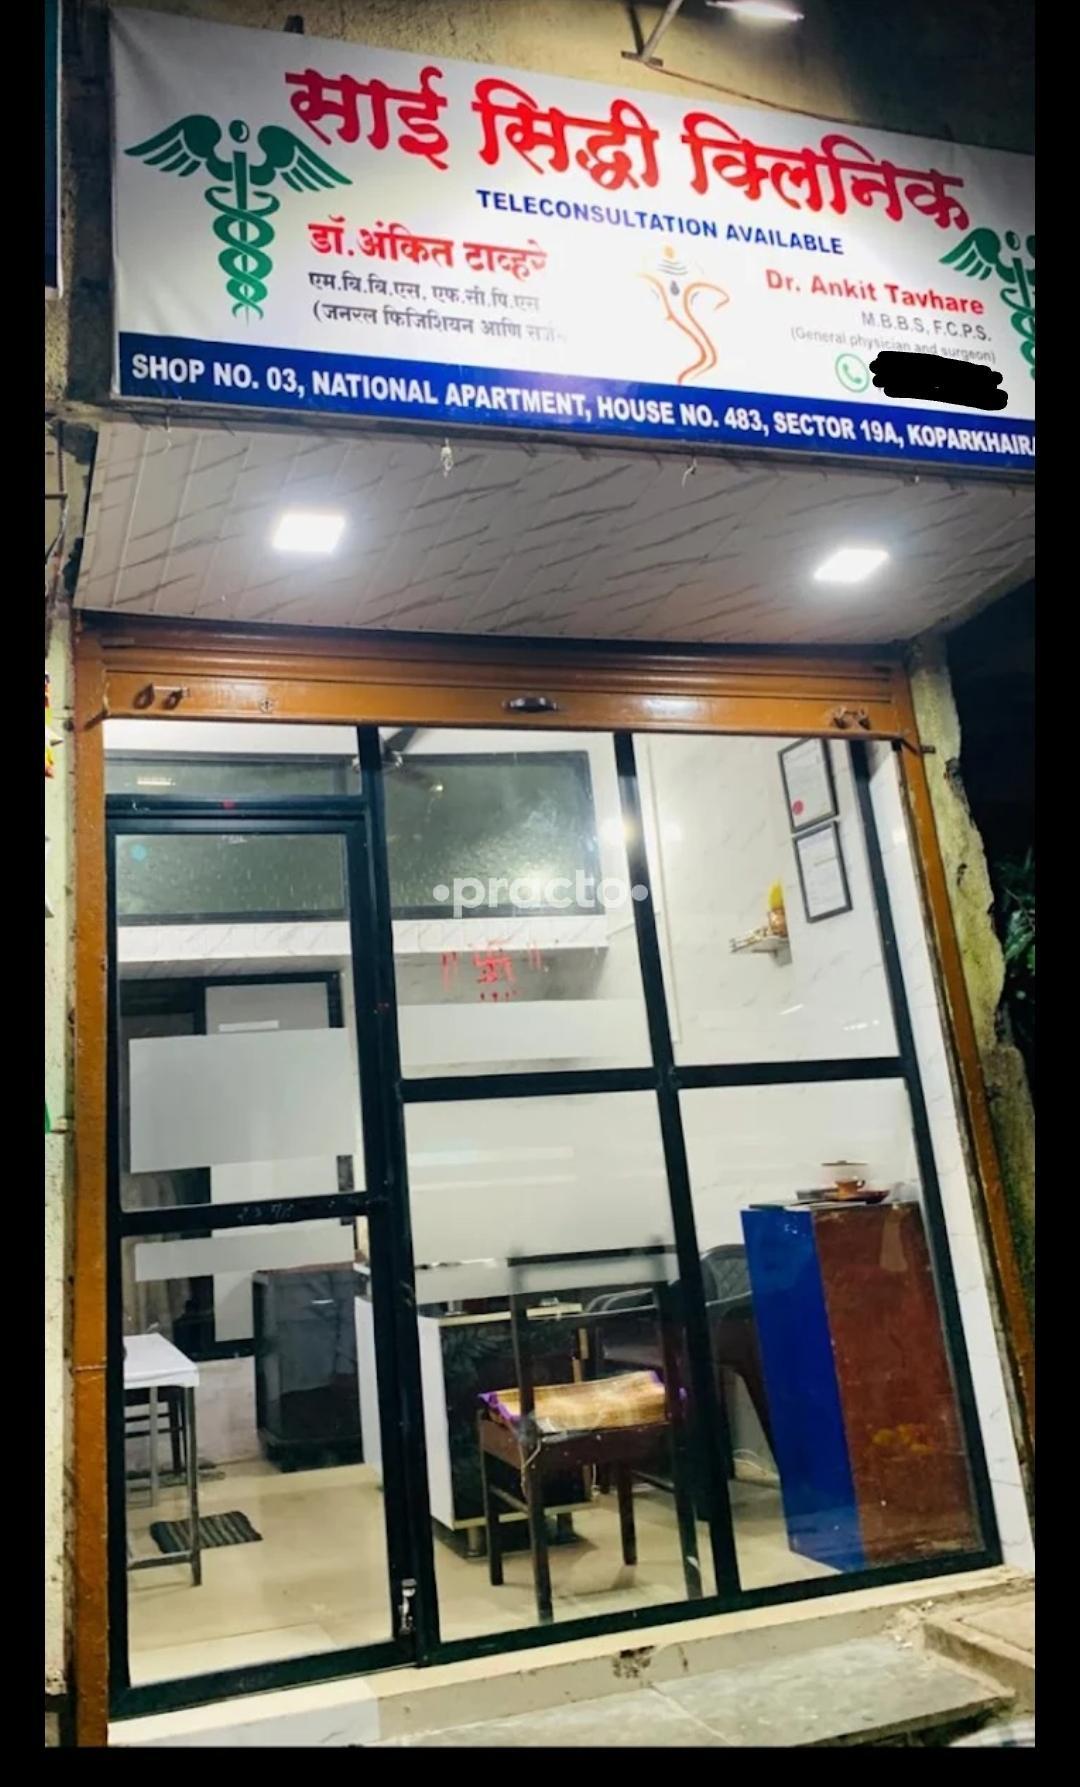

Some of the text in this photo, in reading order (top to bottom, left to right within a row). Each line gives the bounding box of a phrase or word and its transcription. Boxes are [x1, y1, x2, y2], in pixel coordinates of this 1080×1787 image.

[285, 66, 970, 230] साई सिद्धी क्लिनिक
[476, 189, 845, 255] TELECONSULTATION AVAILABLE
[313, 299, 378, 324] (जनरल
[481, 316, 522, 339] आणि
[765, 268, 985, 316] Dr. Ankit Tavhare
[790, 326, 847, 345] (General
[914, 339, 939, 355] and
[131, 353, 1036, 456] SHOP NO. 03, NATIONAL APARTMENT, HOUSE NO. 483, SECTOR 19A, KOPARKHAIR
